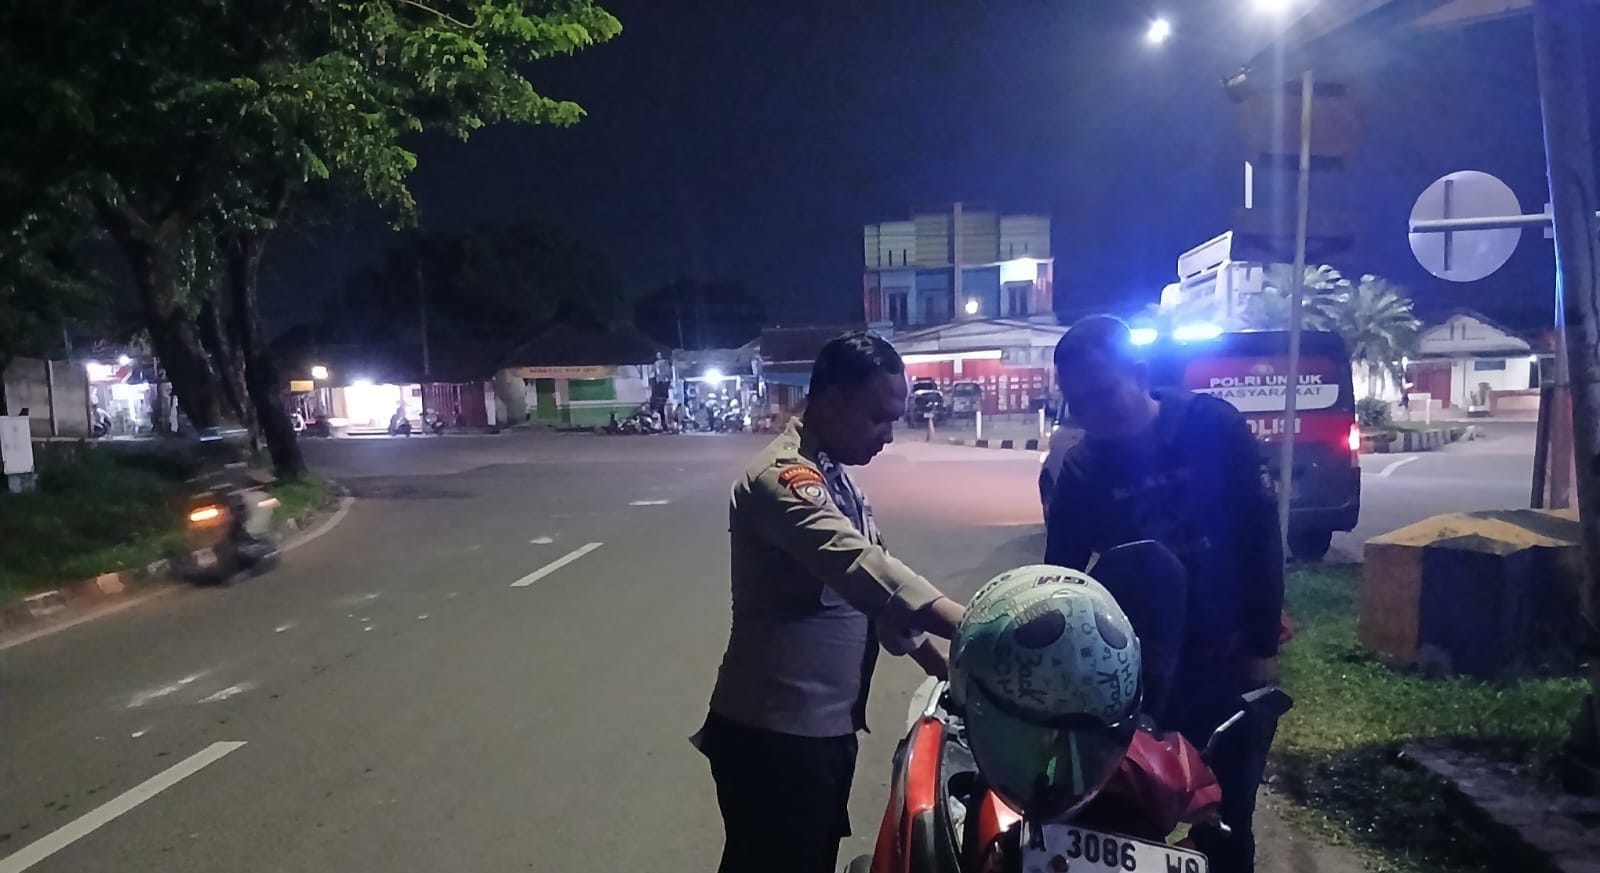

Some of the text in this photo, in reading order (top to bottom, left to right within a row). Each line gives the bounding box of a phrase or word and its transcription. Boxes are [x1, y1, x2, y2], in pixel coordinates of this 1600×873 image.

[1210, 374, 1322, 388] POLRI UNUK
[1067, 829, 1136, 872] 3086
